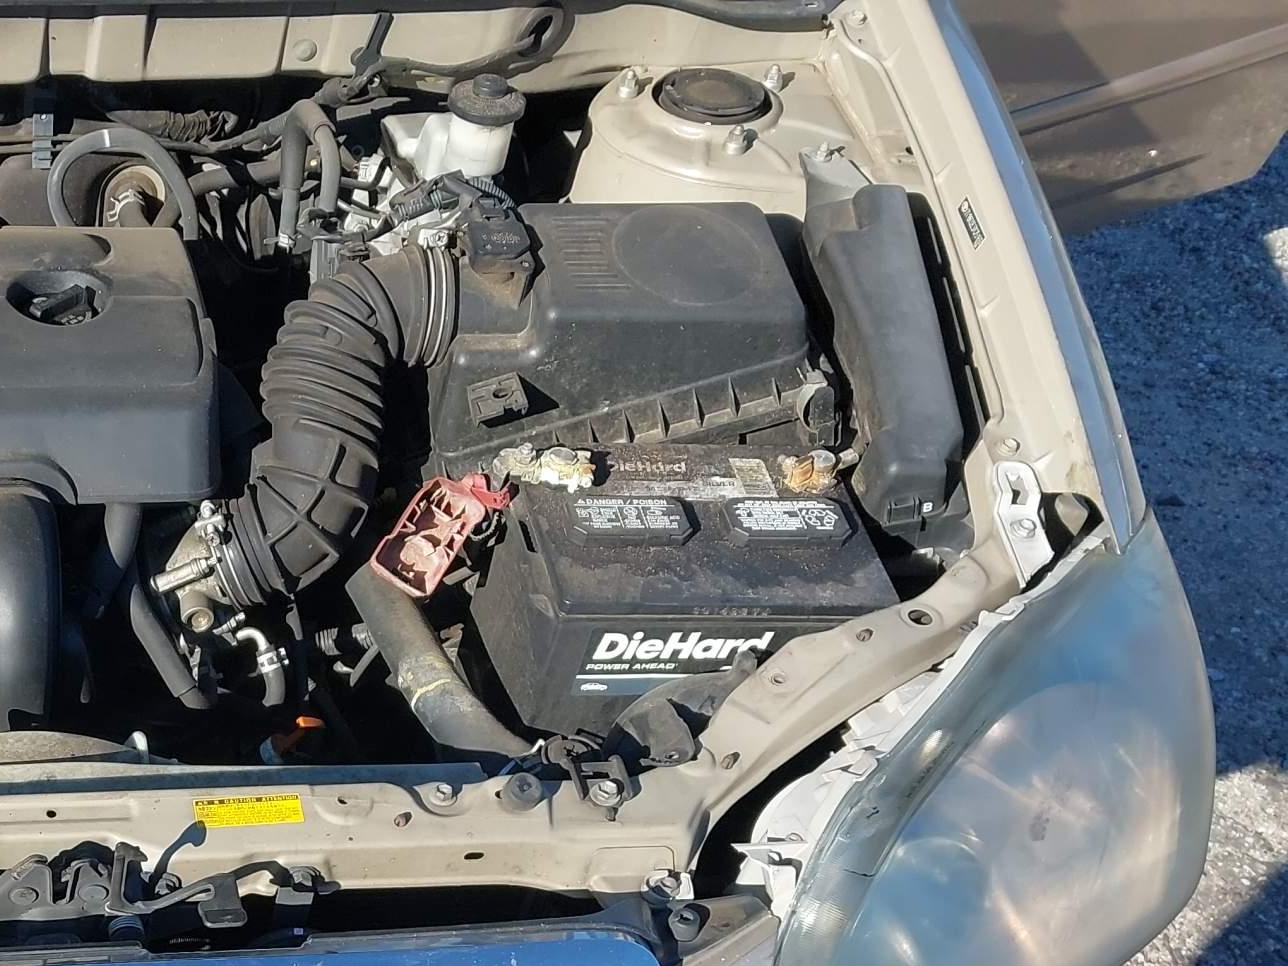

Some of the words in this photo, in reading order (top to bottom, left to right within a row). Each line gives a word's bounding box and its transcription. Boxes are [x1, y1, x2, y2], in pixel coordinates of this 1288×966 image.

[592, 631, 775, 660] DieHard
[585, 663, 630, 671] POWER
[632, 662, 675, 670] AHEAD
